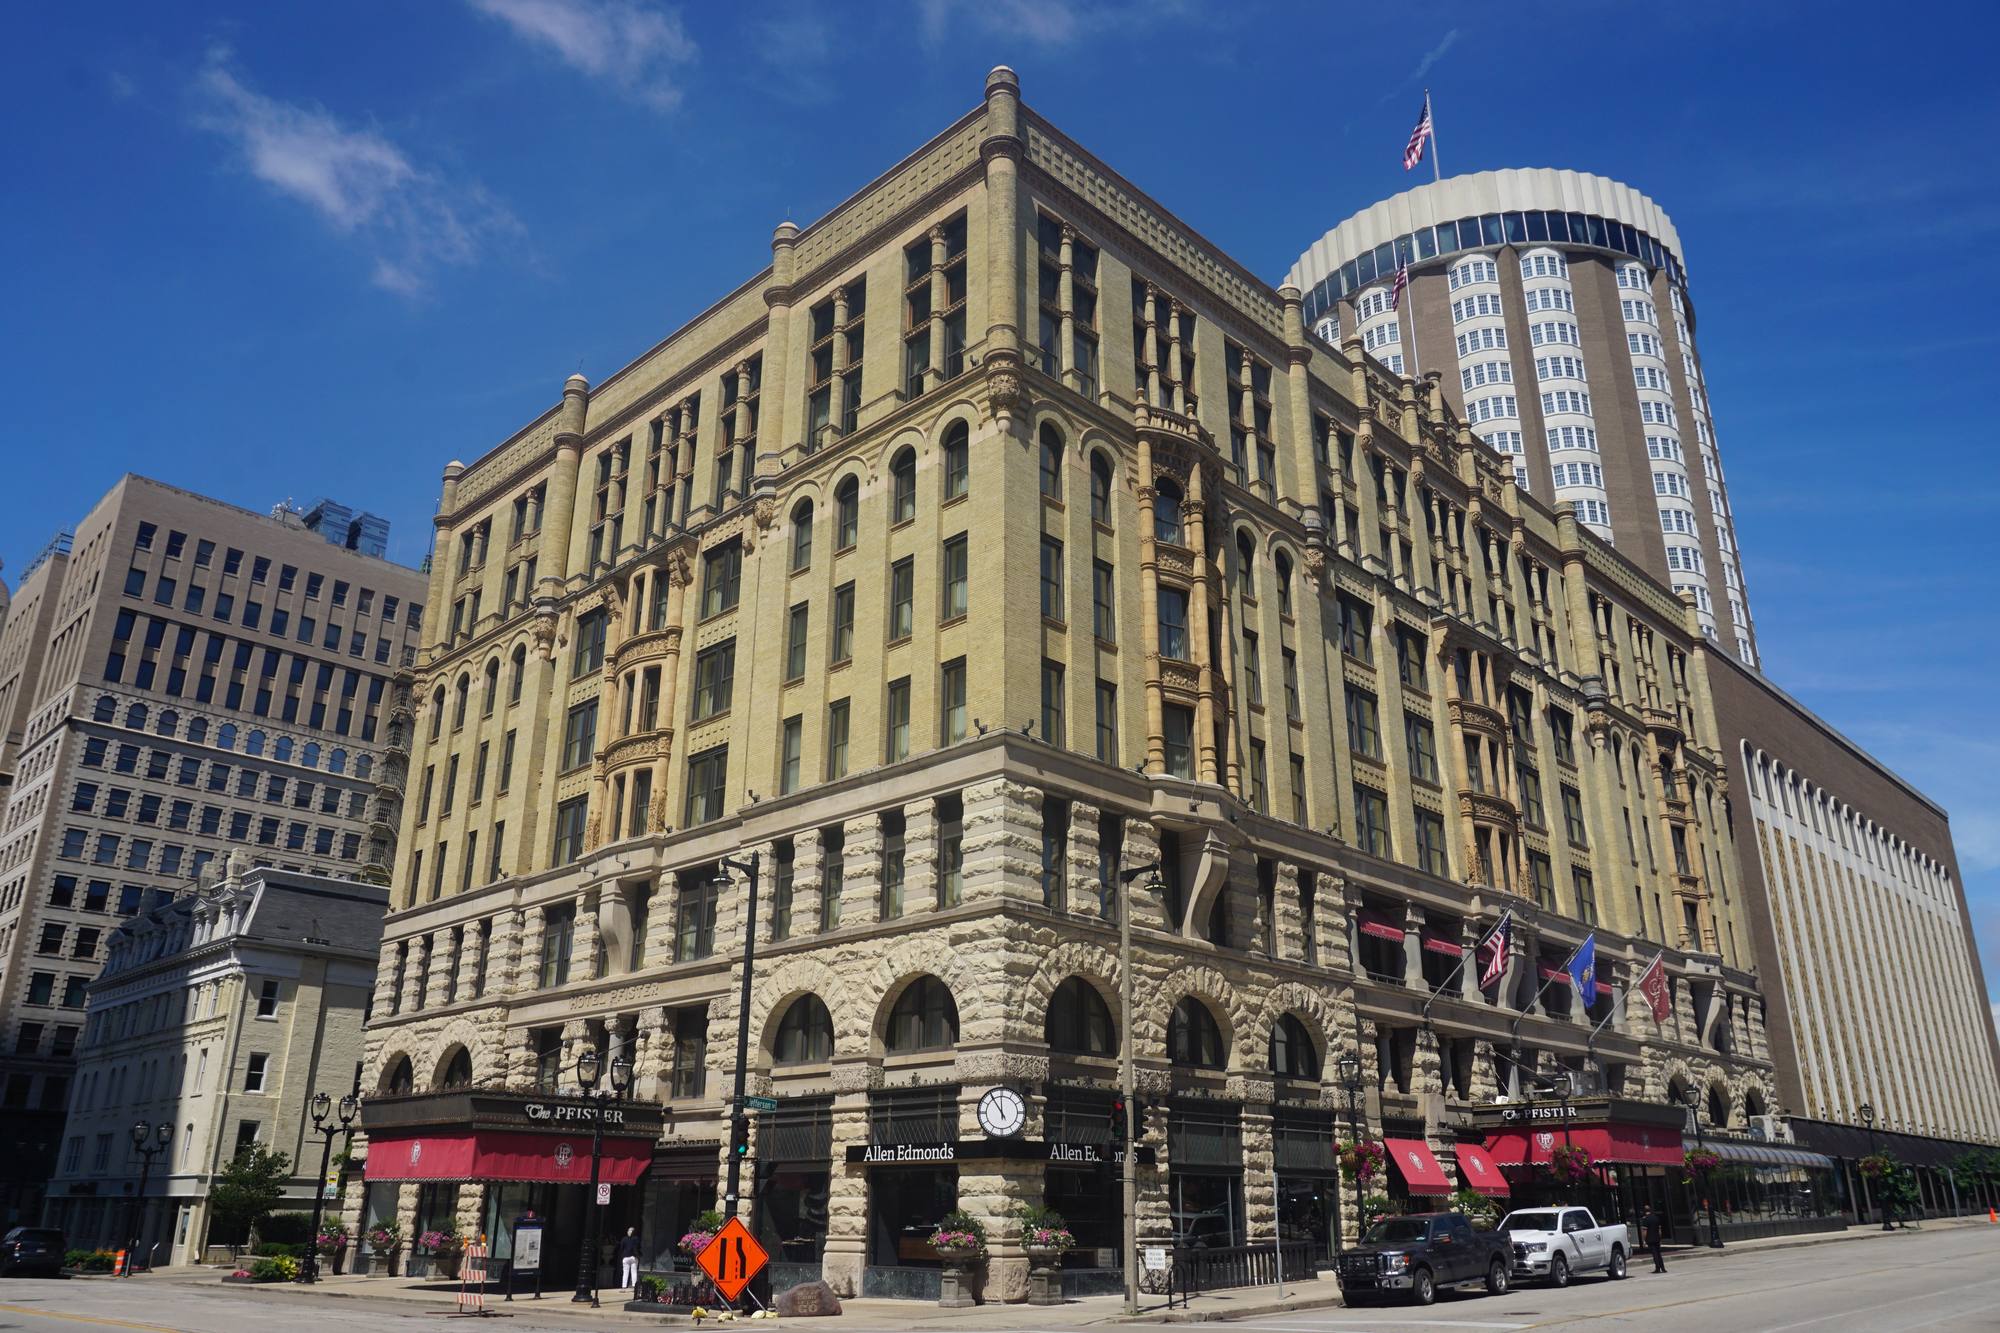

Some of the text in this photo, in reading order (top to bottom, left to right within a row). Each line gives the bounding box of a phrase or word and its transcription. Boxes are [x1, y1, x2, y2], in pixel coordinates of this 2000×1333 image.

[568, 982, 659, 1010] HOTEL PFISTER
[525, 1104, 551, 1119] The
[863, 1142, 954, 1161] Allen Edmonds
[1049, 1143, 1138, 1164] Allen Edns
